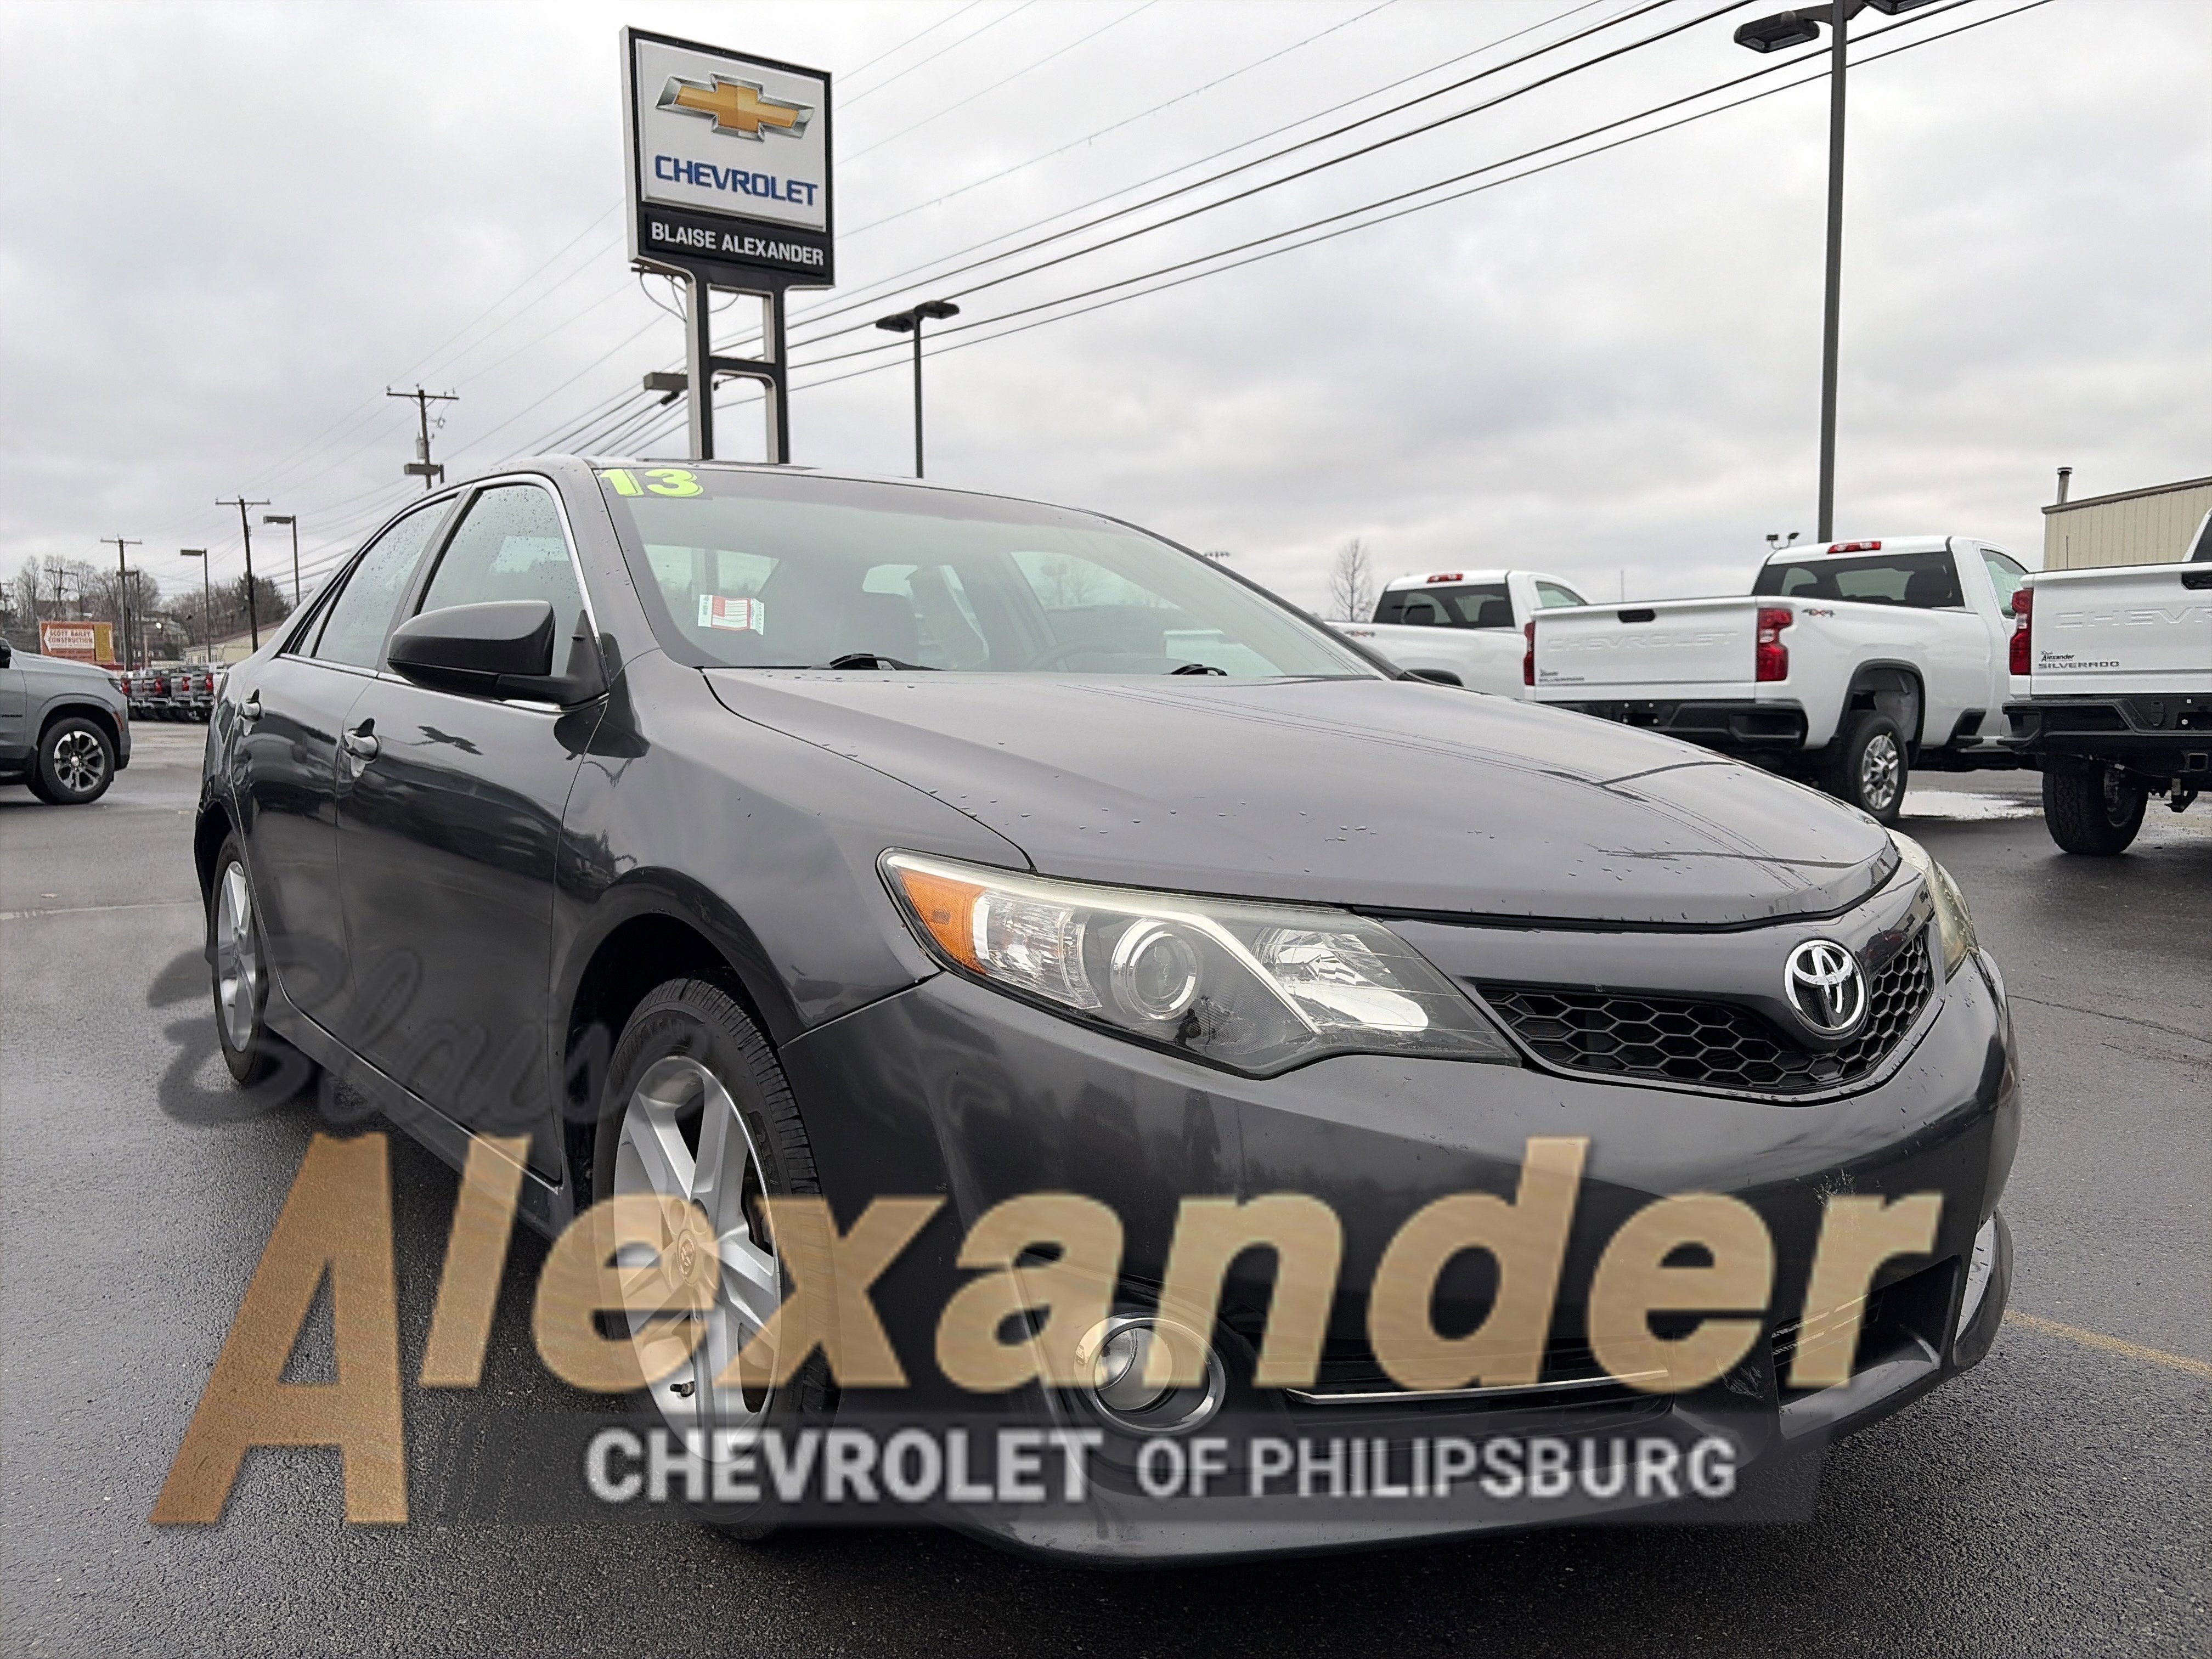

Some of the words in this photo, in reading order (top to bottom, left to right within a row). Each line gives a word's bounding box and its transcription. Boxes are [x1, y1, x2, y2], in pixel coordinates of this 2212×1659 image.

[655, 155, 818, 206] CHEVROLET
[652, 222, 716, 250] BLAISE
[722, 234, 823, 267] ALEXANDER
[600, 469, 704, 497] 13
[1548, 631, 1739, 652] CHEVROLET
[2039, 661, 2119, 669] SILVERADO
